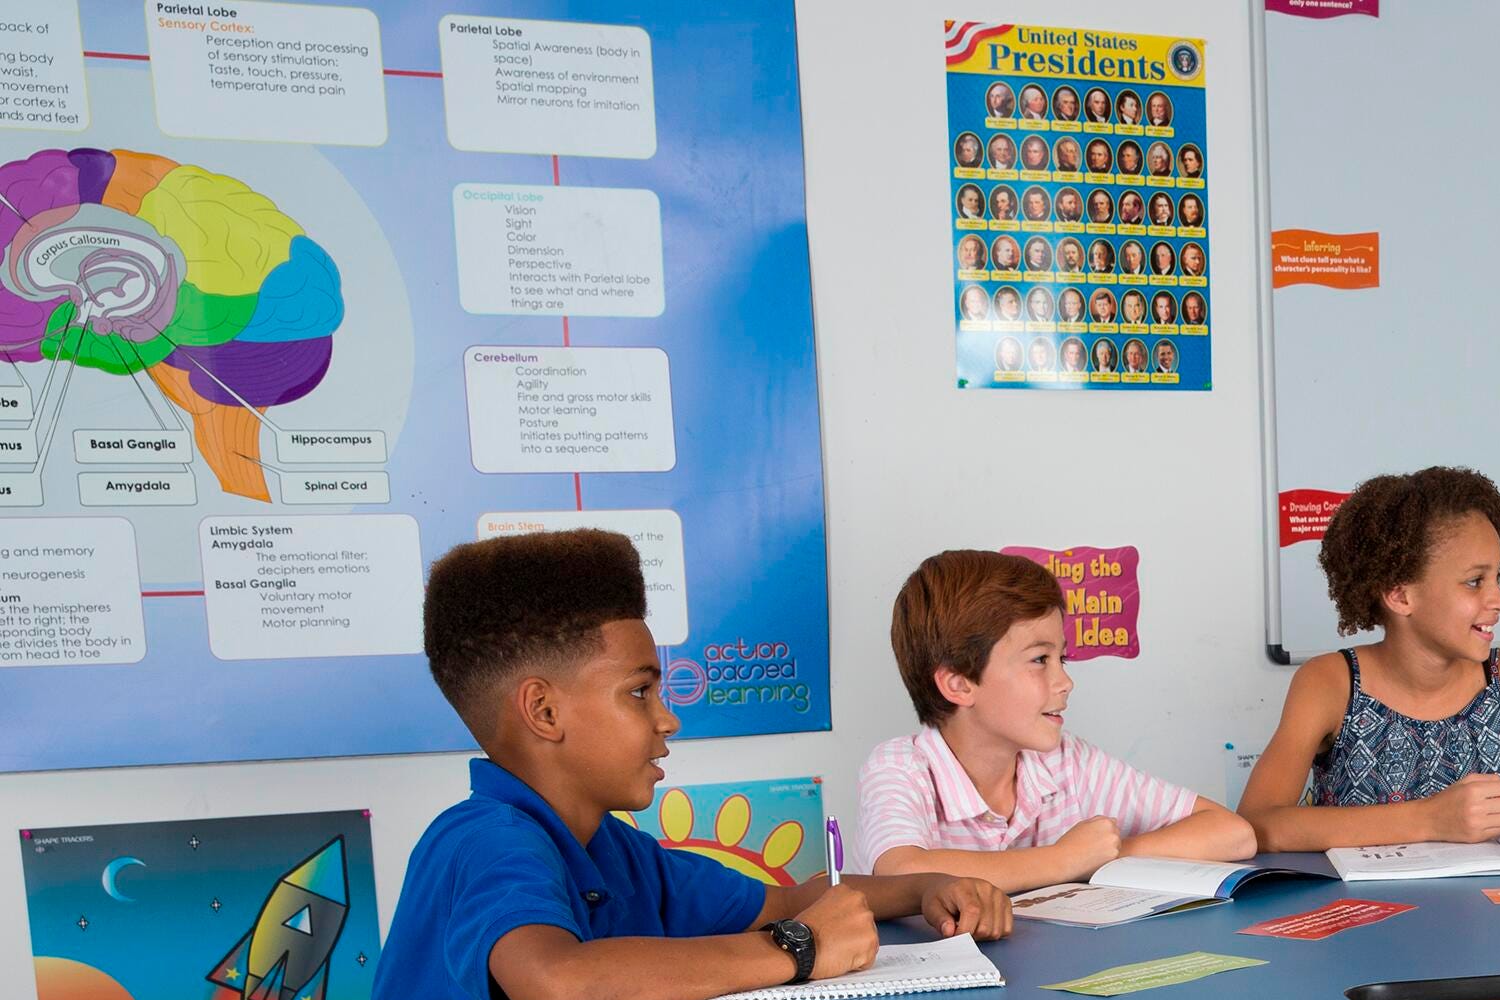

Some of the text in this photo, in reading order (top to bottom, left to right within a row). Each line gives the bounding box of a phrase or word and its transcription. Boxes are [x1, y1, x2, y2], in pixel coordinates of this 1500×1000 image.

[156, 2, 236, 17] Parietal Lobe
[36, 23, 48, 34] of
[158, 17, 206, 33] Sensory
[450, 22, 522, 36] Parietal Lobe
[206, 34, 368, 56] Perception and processing
[1017, 28, 1138, 50] United States
[492, 39, 640, 59] Spatial Awareness (body in
[19, 51, 53, 66] body
[207, 48, 219, 59] of
[223, 52, 267, 65] sensory
[493, 54, 532, 68] space)
[988, 43, 1166, 81] Presidents
[495, 67, 638, 83] Awareness of environment
[0, 79, 68, 93] movement
[210, 78, 345, 98] temperature and pain
[495, 81, 586, 97] Spatial mapping
[13, 95, 54, 108] cortex
[58, 97, 66, 108] is
[26, 110, 78, 123] and feet
[504, 205, 536, 215] Vision
[505, 218, 531, 231] Sight
[506, 232, 536, 242] Color
[36, 234, 120, 267] Corpus Callosum
[507, 245, 564, 256] Dimension
[508, 259, 571, 272] Perspective
[509, 272, 650, 284] Interacts with Parietal lobe
[473, 352, 538, 363] Cerebellum
[515, 366, 586, 376] Coordination
[516, 379, 548, 391] Agility
[517, 392, 651, 404] Fine and gross motor skills
[518, 405, 596, 417] Motor learning
[519, 418, 558, 427] Posture
[90, 439, 175, 452] Basal Ganglia
[291, 434, 371, 447] Hippocampus
[106, 481, 170, 494] Amygdala
[304, 480, 367, 493] Spinal Cord
[1289, 502, 1322, 515] Drawing
[210, 525, 292, 538] Limbic System
[487, 521, 545, 531] Brain Stem
[211, 539, 273, 552] Amygdala
[13, 546, 39, 556] and
[42, 548, 94, 559] memory
[255, 552, 276, 562] The
[279, 551, 338, 561] emotional
[2, 569, 85, 582] neurogenesis
[257, 564, 370, 577] deciphers emotions
[1045, 554, 1122, 584] ding the
[215, 578, 296, 591] Basal Ganglia
[259, 590, 351, 604] Voluntary motor
[1066, 588, 1122, 615] Main
[8, 604, 29, 614] the
[32, 602, 111, 616] hemispheres
[260, 604, 323, 614] movement
[18, 615, 31, 625] to
[69, 614, 89, 624] the
[262, 617, 350, 630] Motor planning
[59, 625, 91, 639] body
[1075, 618, 1129, 647] Idea
[14, 637, 57, 648] divides
[61, 637, 81, 647] the
[84, 636, 117, 649] body
[120, 635, 131, 646] in
[704, 636, 788, 661] action
[25, 648, 60, 659] head
[63, 648, 76, 658] to
[79, 647, 100, 658] toe
[706, 683, 811, 712] learning
[34, 837, 59, 845] SHAPE
